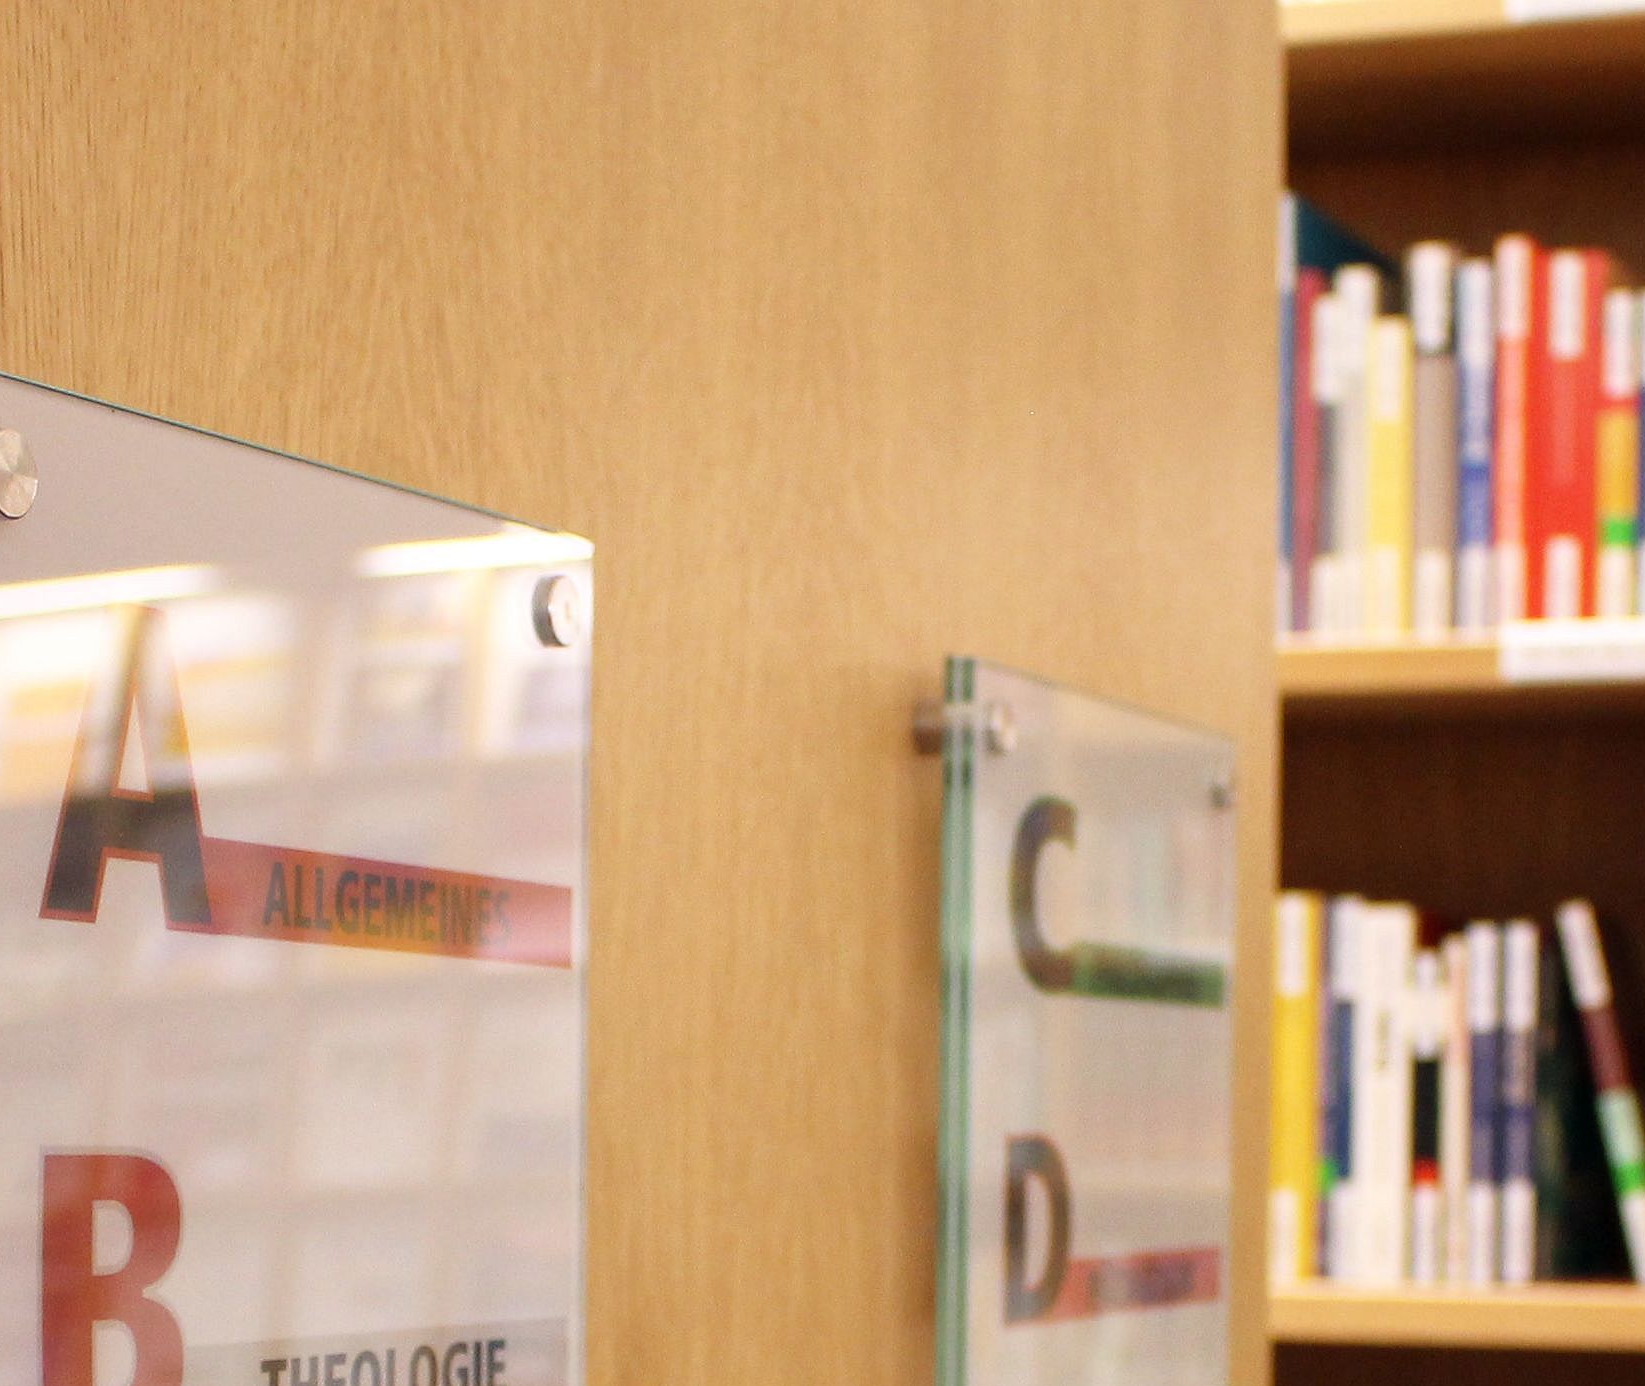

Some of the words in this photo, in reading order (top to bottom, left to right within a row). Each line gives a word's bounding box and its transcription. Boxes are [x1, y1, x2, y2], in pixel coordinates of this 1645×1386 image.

[39, 603, 213, 932] A
[262, 862, 511, 948] ALLGEMEINES
[1009, 795, 1078, 996] C
[1003, 1133, 1071, 1327] D
